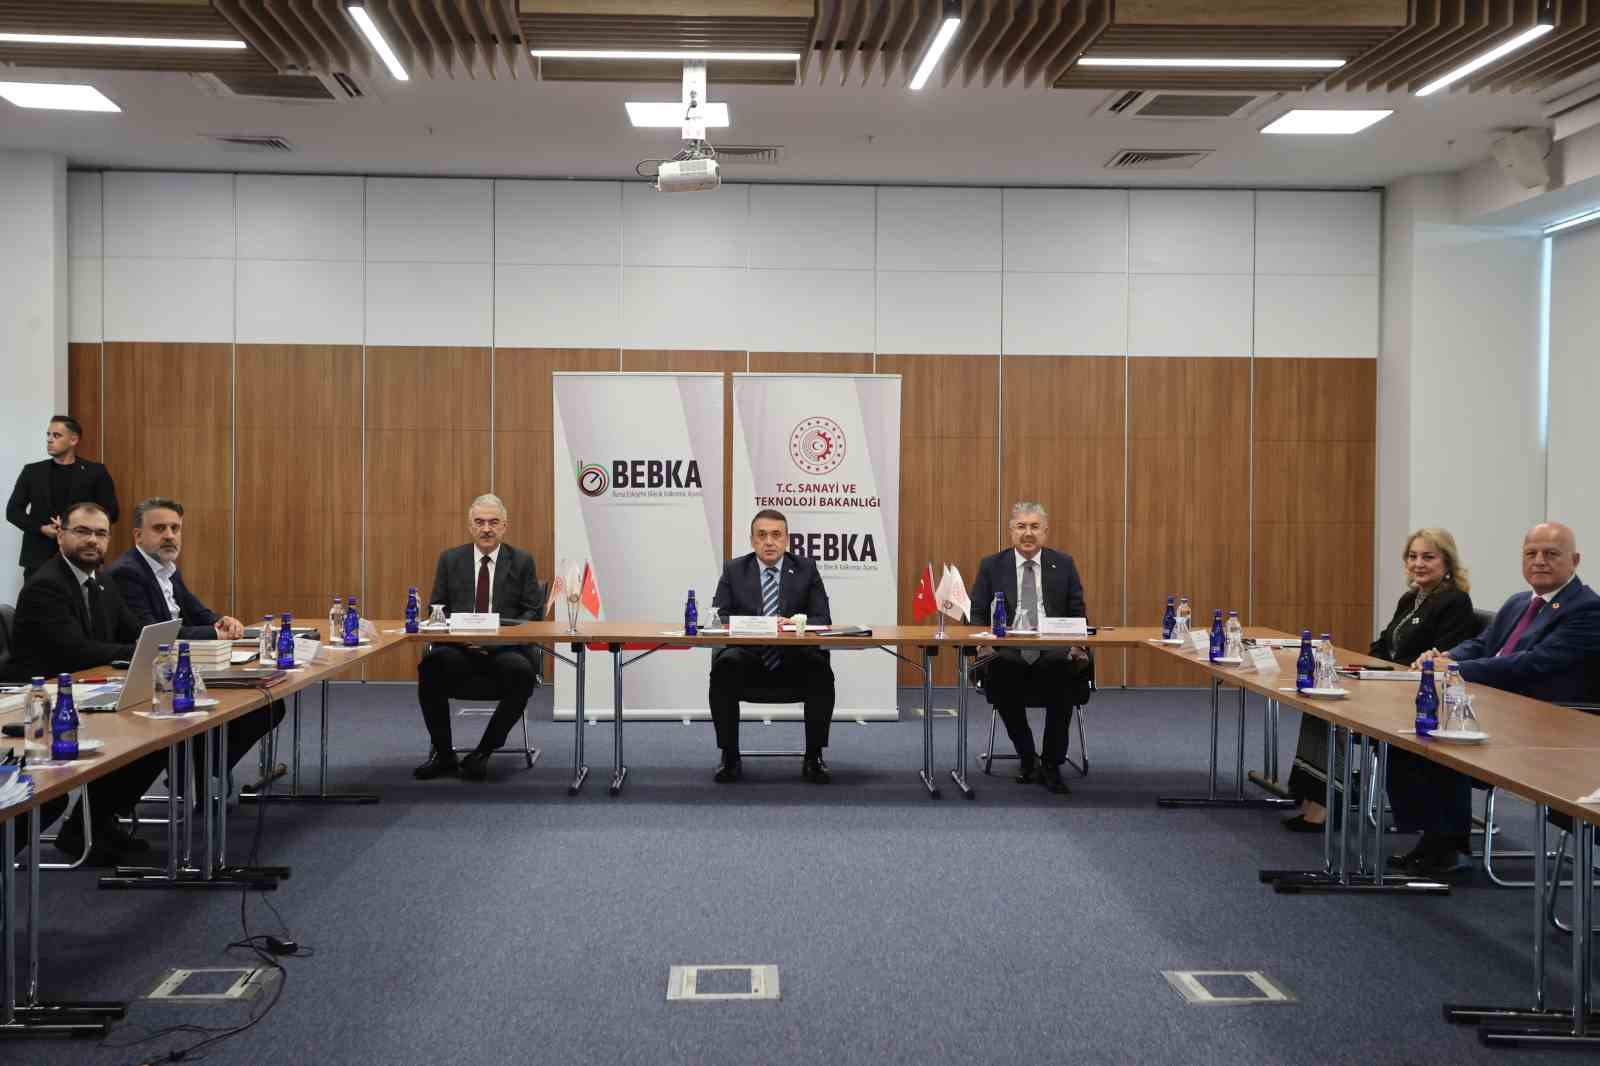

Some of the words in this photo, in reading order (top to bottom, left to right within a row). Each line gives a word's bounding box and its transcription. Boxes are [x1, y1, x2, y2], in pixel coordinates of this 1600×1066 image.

[612, 460, 702, 489] BEBKA
[776, 483, 796, 493] T.C.
[798, 482, 839, 493] SANAYİ
[842, 483, 856, 493] VE
[755, 496, 816, 506] TEKNOLOJİ
[819, 496, 881, 507] BAKANLIĞI
[789, 533, 877, 562] BEBKA
